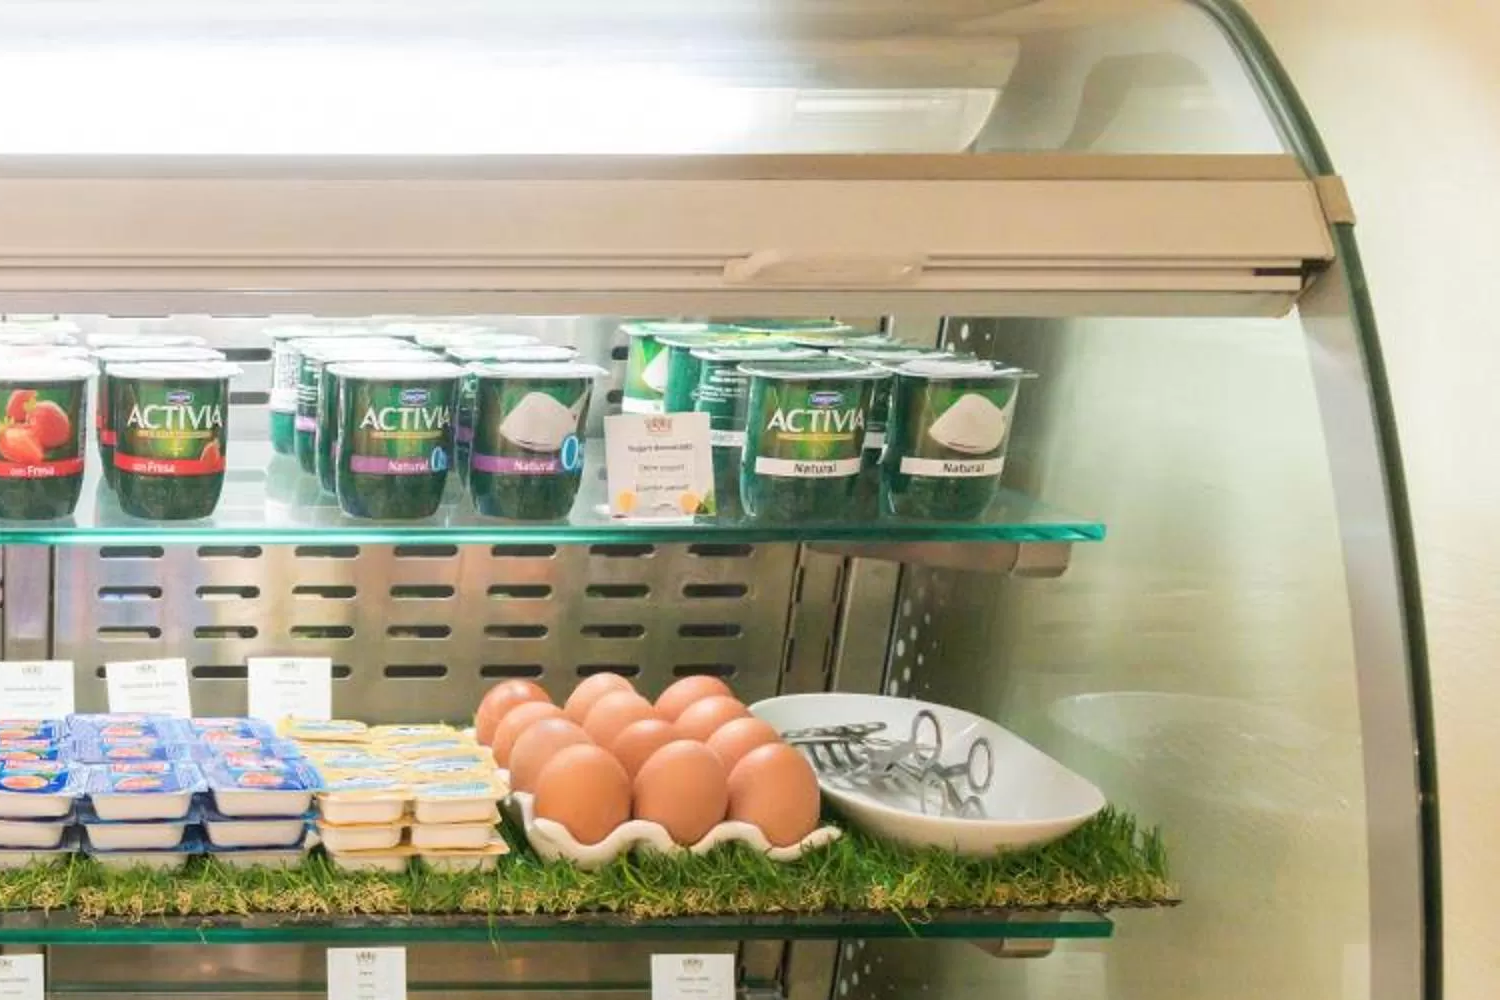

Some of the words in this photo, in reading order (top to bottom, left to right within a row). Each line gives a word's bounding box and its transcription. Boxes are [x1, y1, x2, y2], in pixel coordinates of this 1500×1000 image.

[127, 403, 223, 430] ACTIVIA
[767, 407, 865, 433] ACTIVIA
[147, 462, 176, 474] Fresa
[793, 462, 837, 475] Natural
[943, 463, 985, 474] Natural
